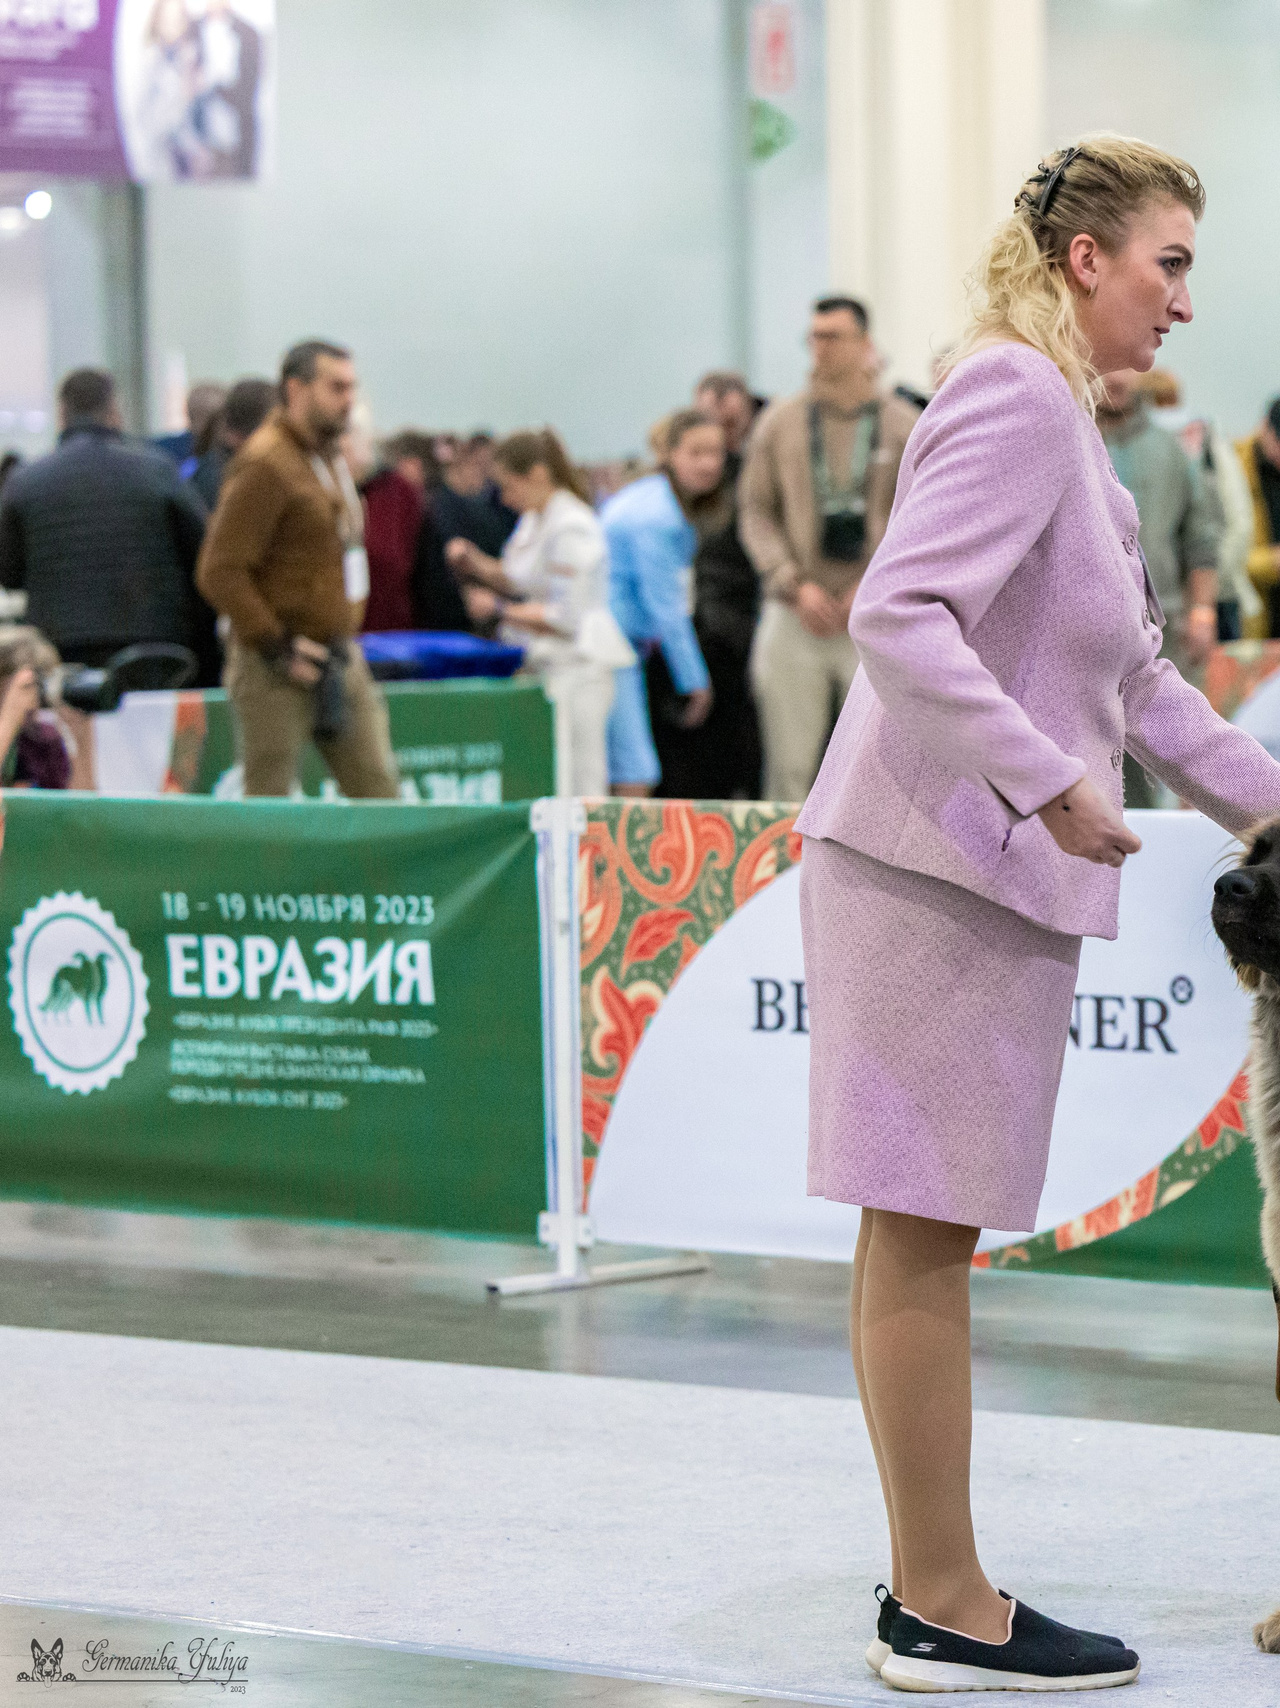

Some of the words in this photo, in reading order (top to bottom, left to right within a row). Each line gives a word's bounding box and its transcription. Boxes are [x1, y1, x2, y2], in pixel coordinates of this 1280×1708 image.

[161, 892, 189, 921] 18
[216, 893, 246, 921] 19
[252, 893, 366, 924] НОЯБРЯ
[373, 895, 435, 925] 2023
[165, 933, 436, 1005] ЕВРАЗИЯ
